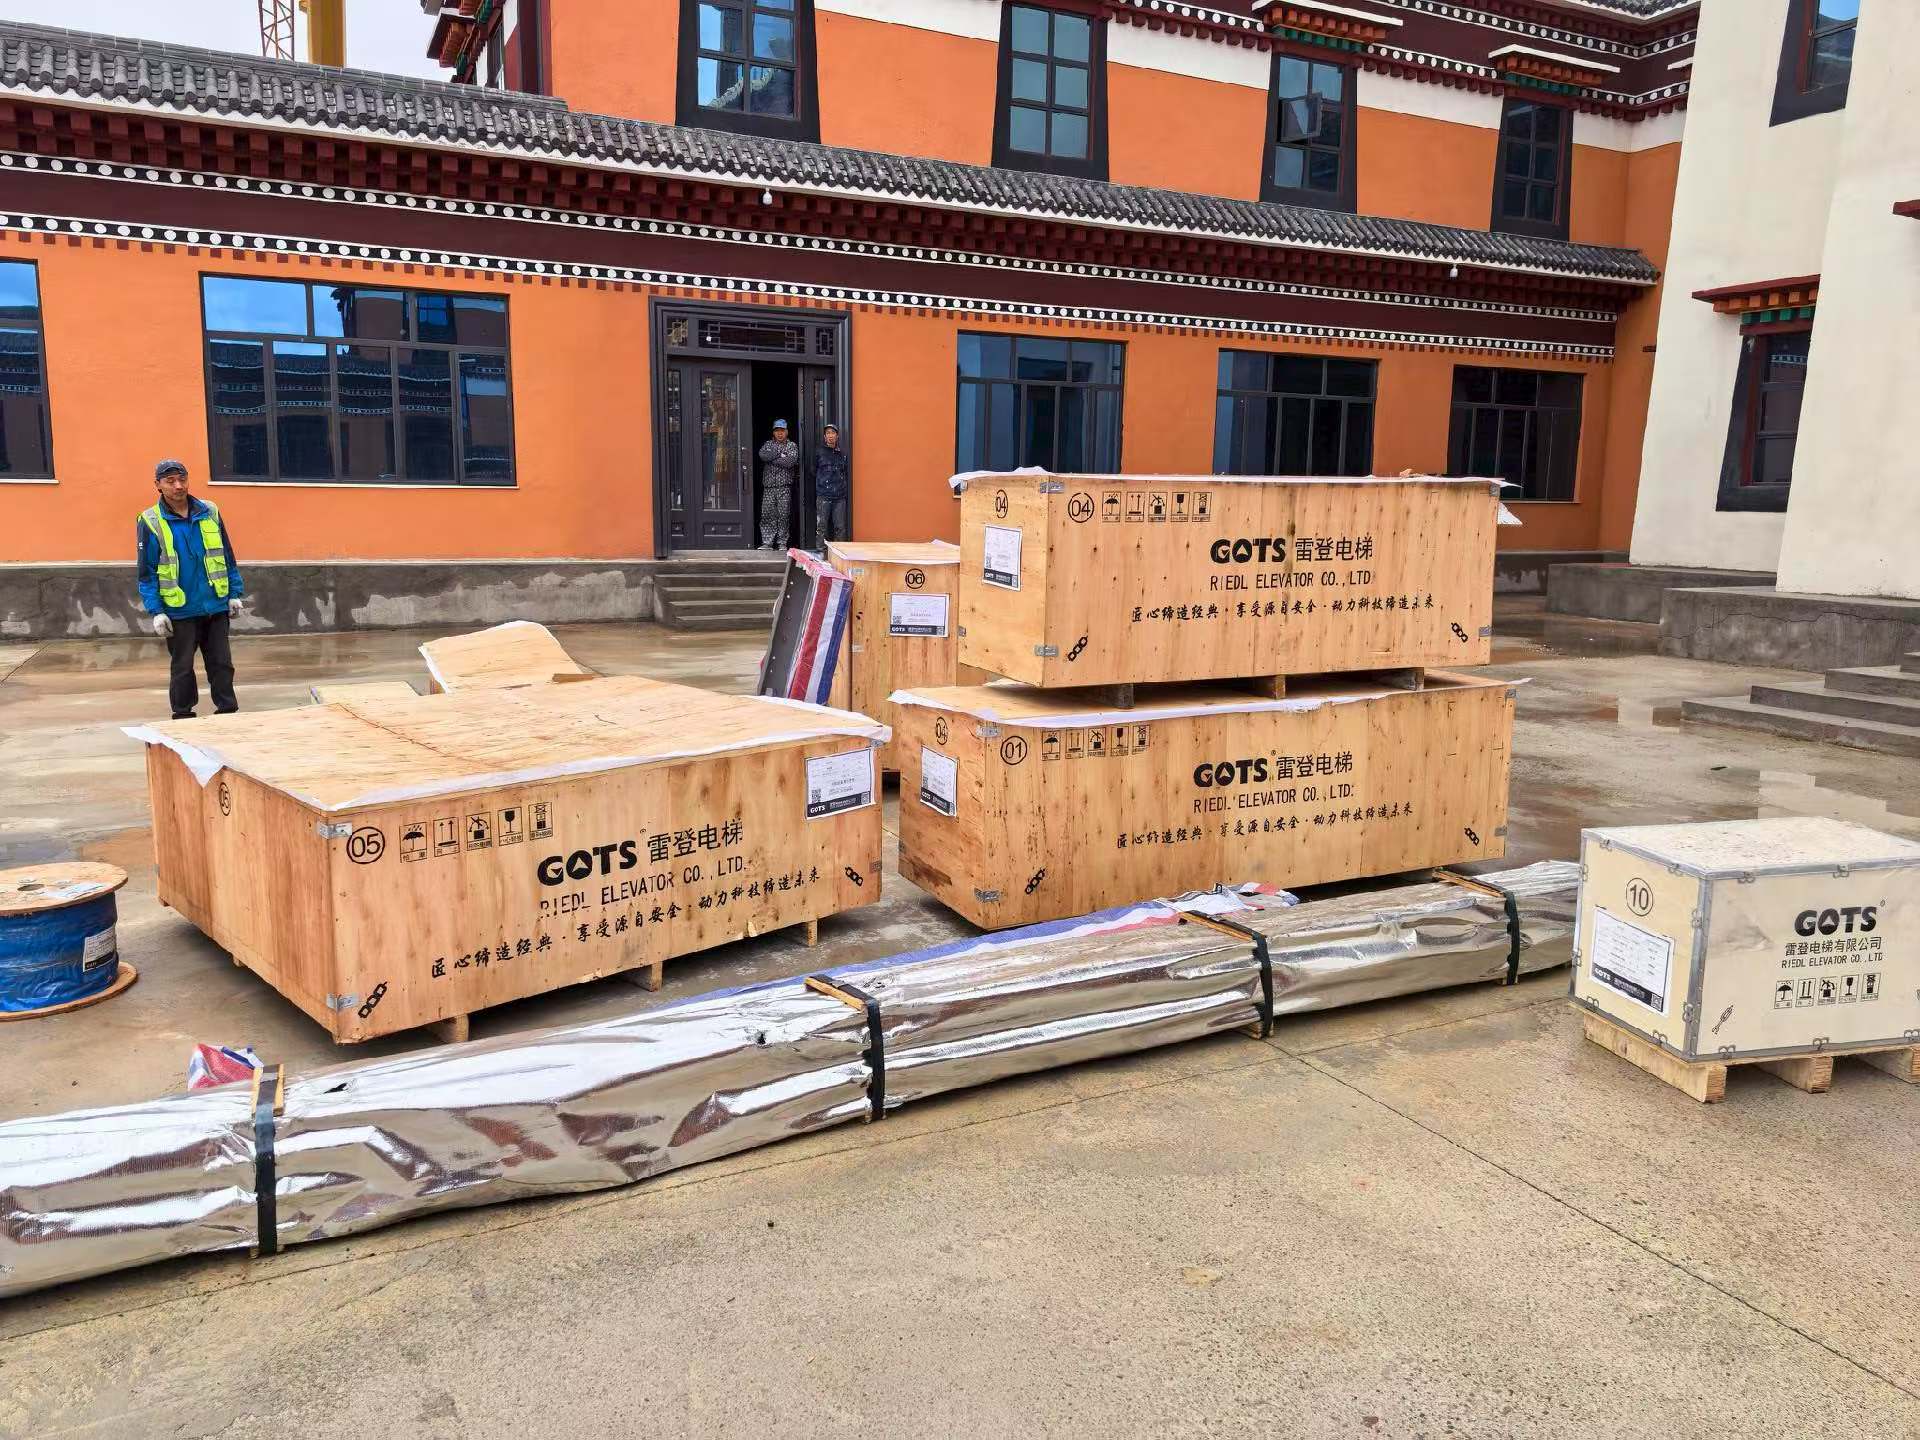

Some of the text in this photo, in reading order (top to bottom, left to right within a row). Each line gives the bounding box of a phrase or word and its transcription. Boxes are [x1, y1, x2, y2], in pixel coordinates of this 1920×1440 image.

[1071, 499, 1091, 517] 04
[1210, 536, 1373, 564] GOTS 雷登电梯
[1210, 575, 1248, 591] RIEDL
[1256, 572, 1314, 589] ELEVATOR
[1005, 741, 1023, 759] 01
[1193, 751, 1353, 788] GOTS 雷登电梯
[1193, 796, 1231, 814] RIEDL
[1238, 789, 1297, 809] ELEVATOR
[351, 833, 381, 858] 05
[537, 818, 743, 887] GOTS 雷登电梯
[601, 871, 674, 905] ELEVATOR
[1629, 884, 1650, 908] 10
[1794, 906, 1877, 937] GOTS
[1785, 936, 1882, 957] 雷登电梯有限公司
[1781, 958, 1806, 969] RIEDL
[1809, 955, 1847, 967] ELEVATOR
